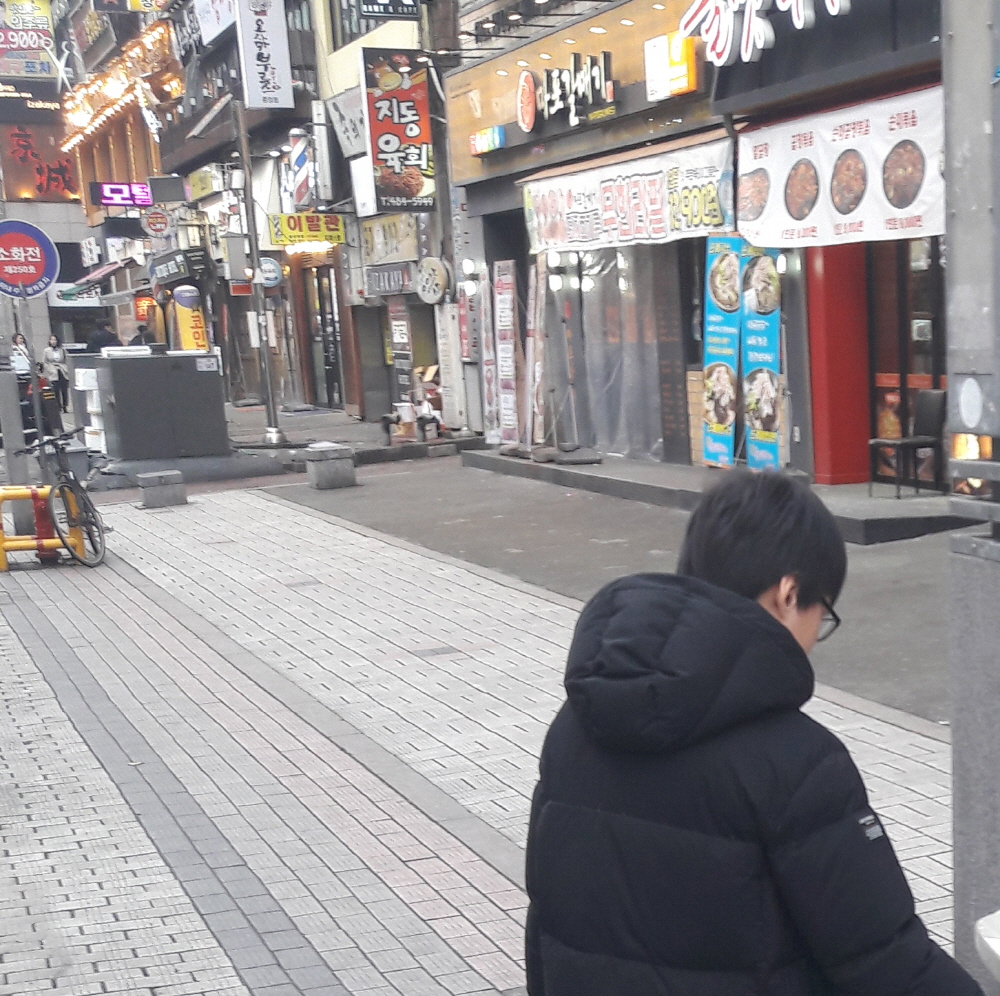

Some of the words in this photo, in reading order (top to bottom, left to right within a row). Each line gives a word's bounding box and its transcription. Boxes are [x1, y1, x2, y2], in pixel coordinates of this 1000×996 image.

[374, 98, 421, 138] 지동
[377, 132, 428, 174] 육회
[101, 183, 153, 206] 모텔
[287, 216, 340, 232] 이발관
